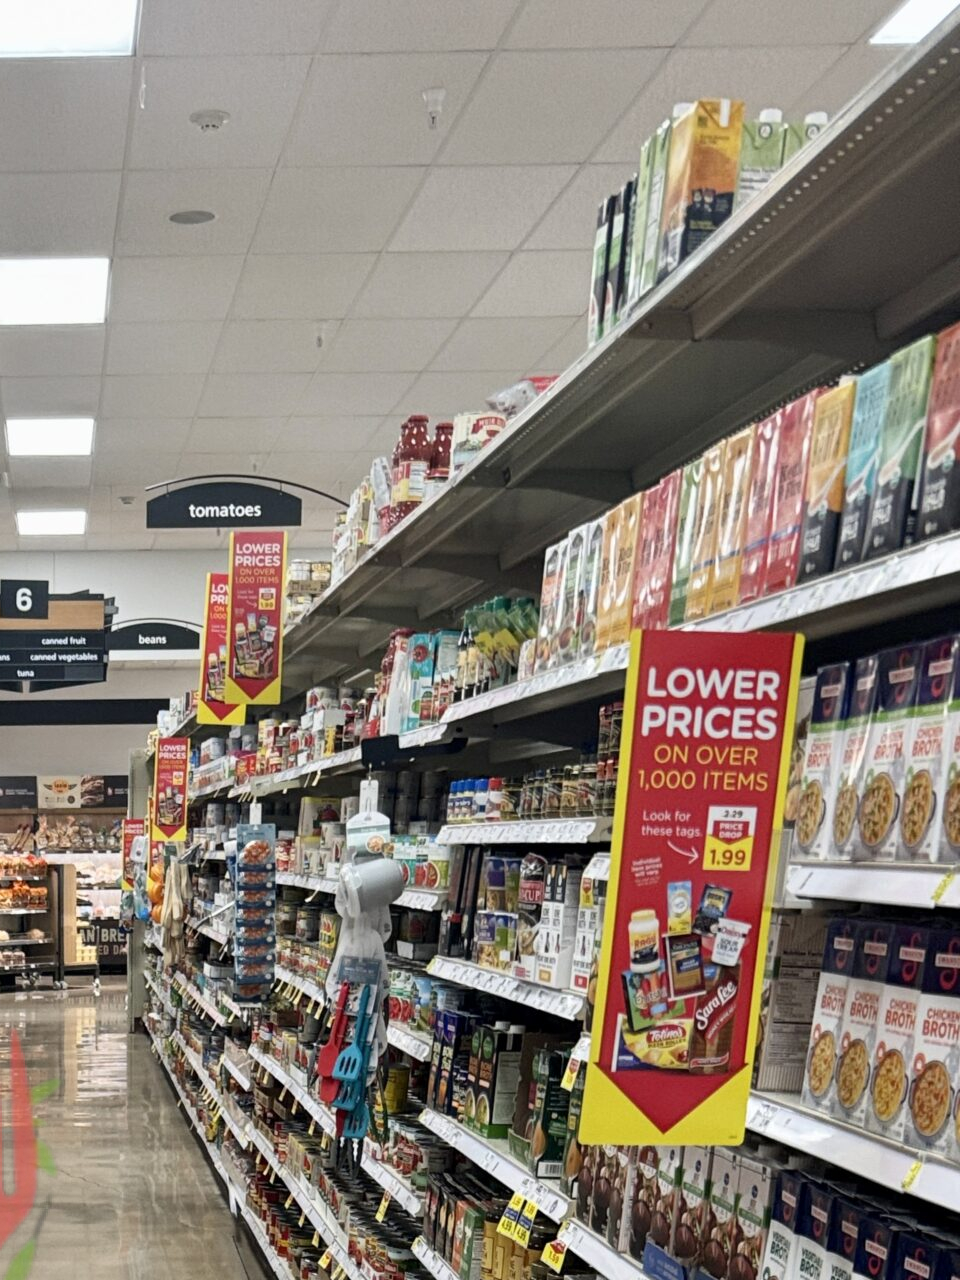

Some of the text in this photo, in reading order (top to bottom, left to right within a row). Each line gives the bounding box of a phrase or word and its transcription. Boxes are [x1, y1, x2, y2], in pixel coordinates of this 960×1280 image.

[189, 503, 262, 518] tomatoes
[236, 543, 280, 554] LOWER
[235, 555, 280, 567] PRICES
[16, 588, 32, 612] 6
[41, 637, 86, 645] canned fruit
[138, 633, 167, 645] beans
[30, 653, 98, 663] canned vegetables
[16, 669, 34, 677] tuna
[647, 667, 780, 701] LOWER
[641, 705, 777, 740] PRICES
[159, 744, 186, 752] LOWER
[159, 752, 186, 760] PRICES
[654, 745, 758, 765] ON OVER
[638, 769, 768, 791] 1,000 ITEMS
[643, 810, 691, 821] Look for
[642, 825, 672, 836] these
[720, 822, 743, 831] PRICE
[709, 849, 745, 865] 1.99
[850, 1002, 878, 1019] BROTH
[885, 1010, 916, 1031] BROTH
[922, 1020, 960, 1041] BROTH
[800, 1258, 821, 1280] BROTH
